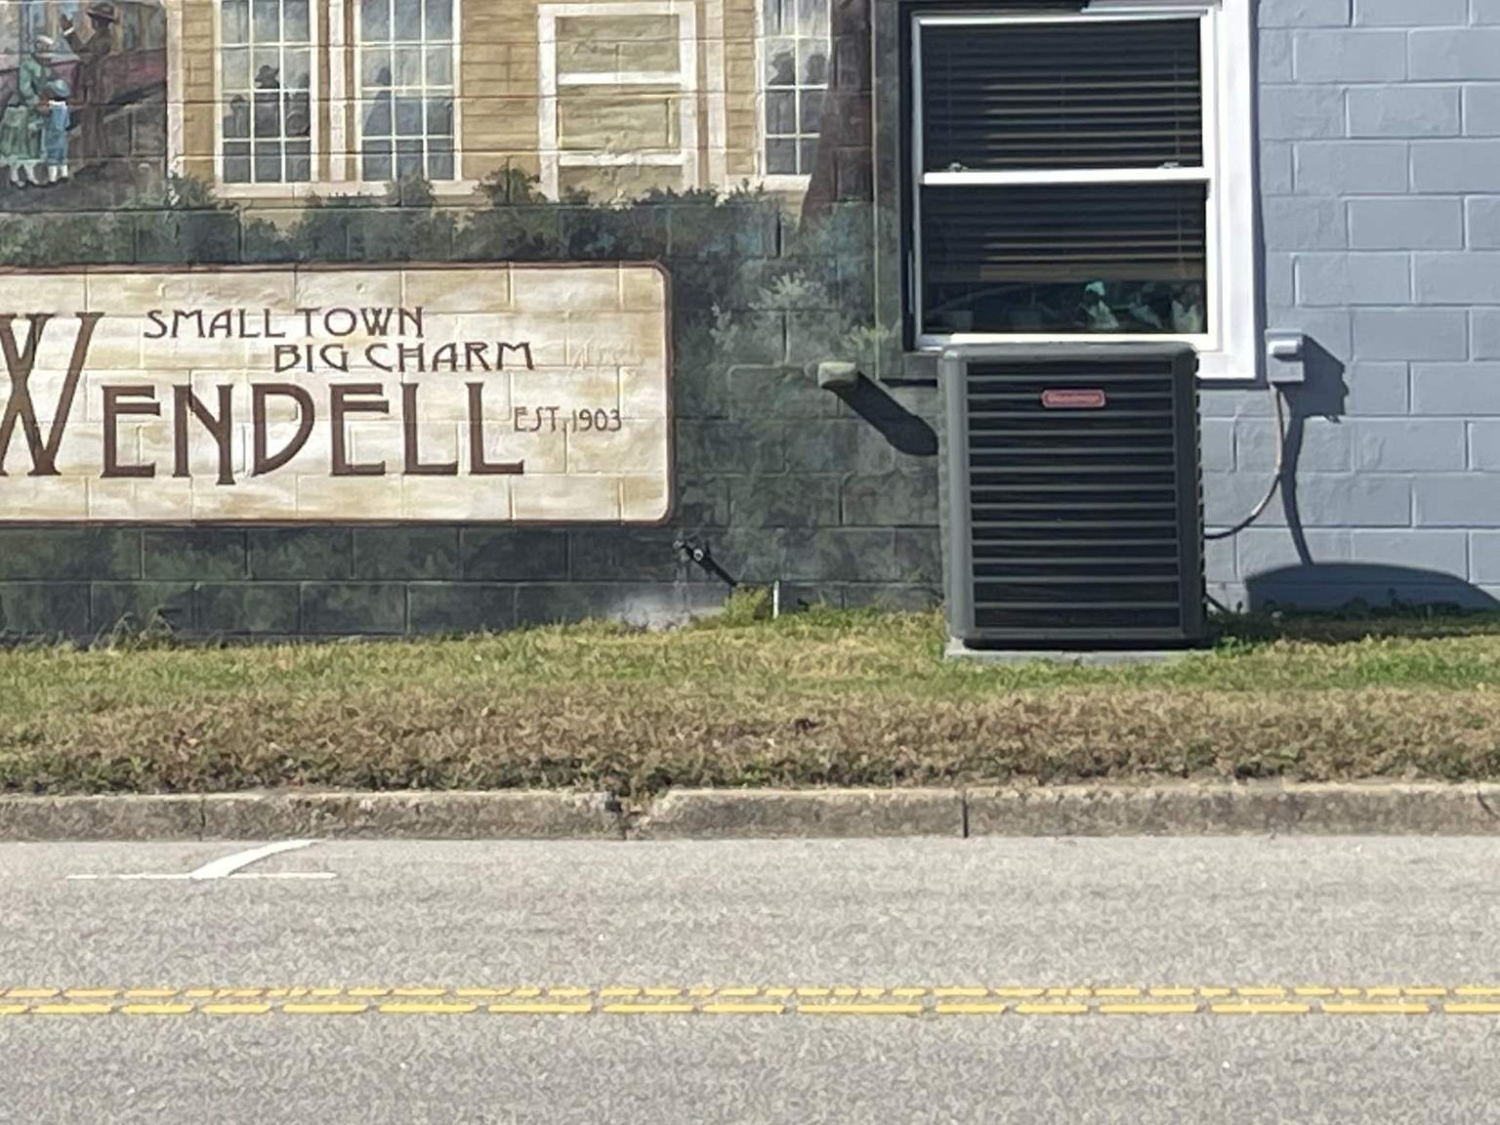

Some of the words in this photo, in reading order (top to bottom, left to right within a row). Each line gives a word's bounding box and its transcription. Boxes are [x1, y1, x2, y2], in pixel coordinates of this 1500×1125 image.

[143, 307, 287, 338] SMALL
[295, 306, 425, 339] TOWN
[273, 343, 352, 373] BIG
[367, 341, 534, 373] CHARM
[571, 408, 622, 433] 1903
